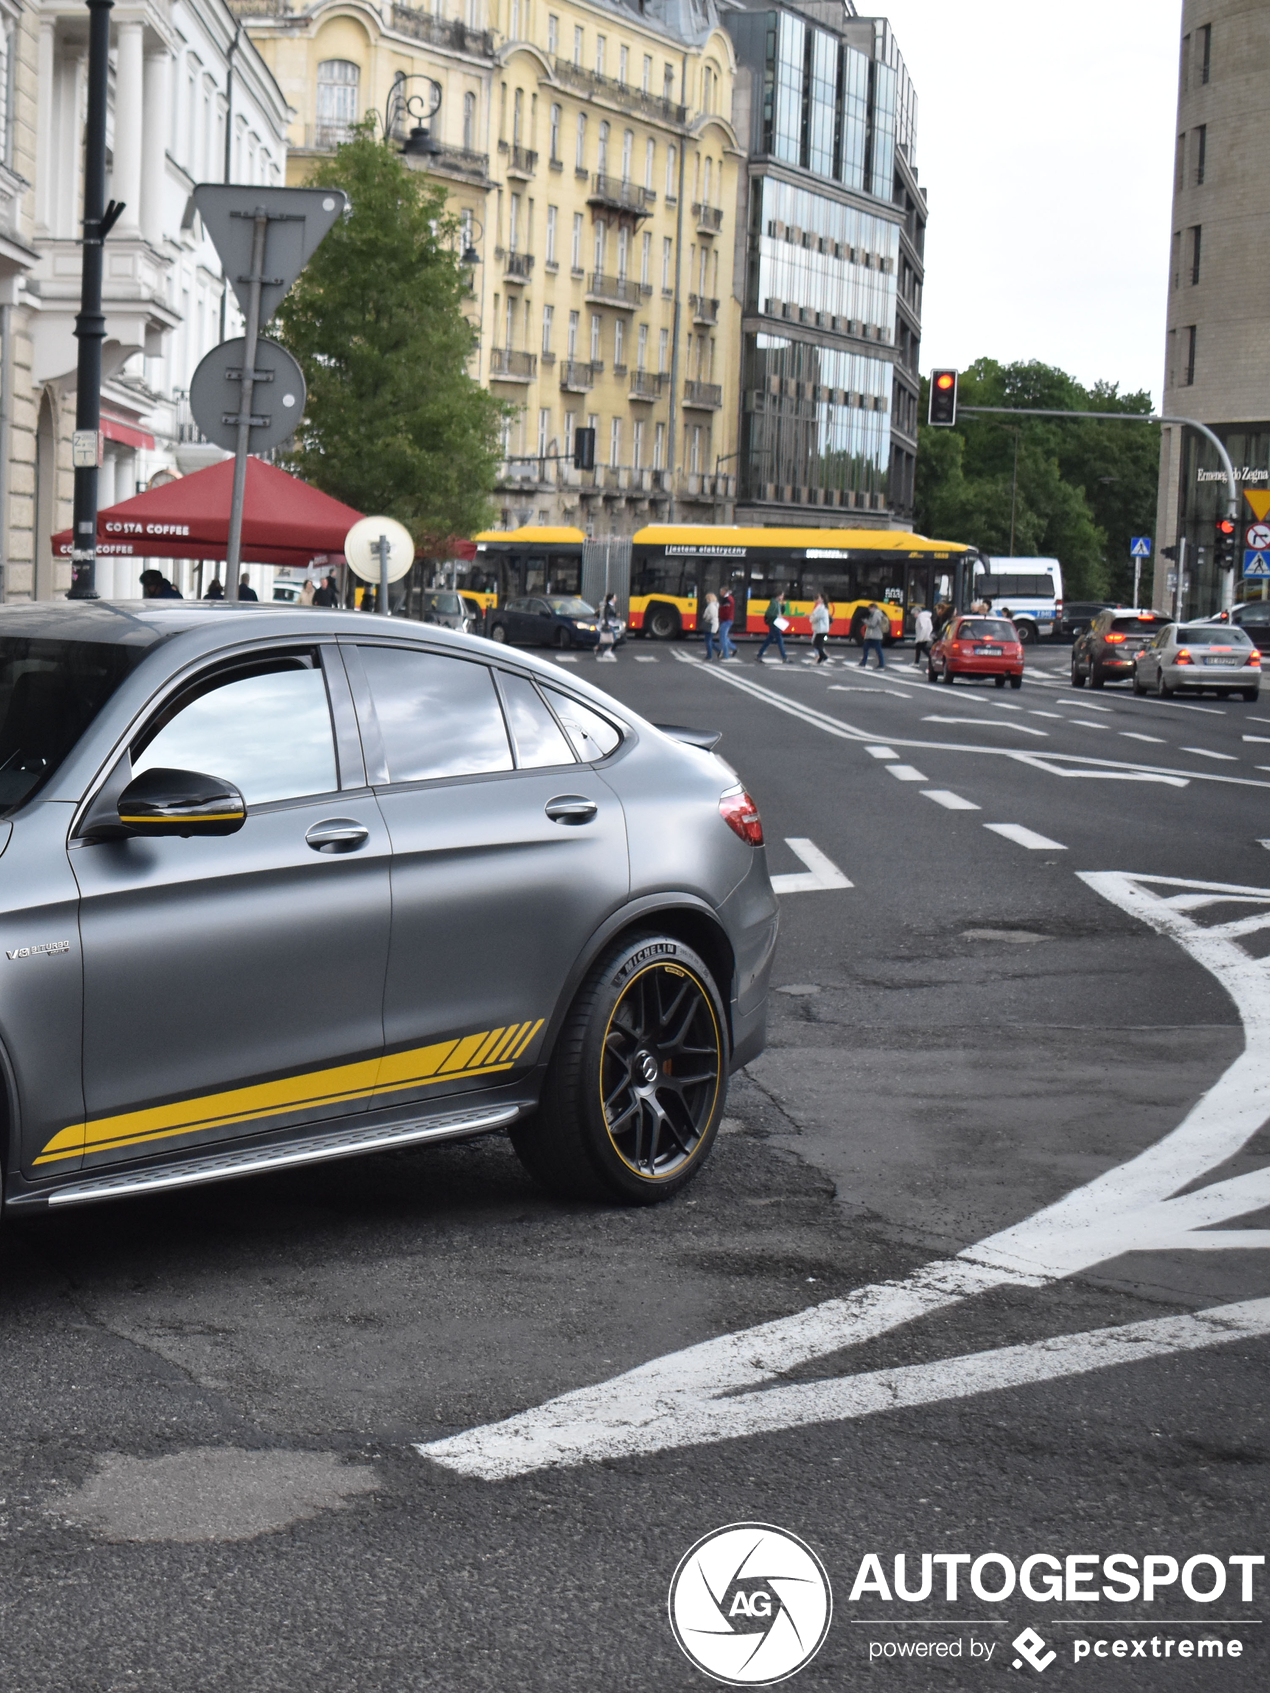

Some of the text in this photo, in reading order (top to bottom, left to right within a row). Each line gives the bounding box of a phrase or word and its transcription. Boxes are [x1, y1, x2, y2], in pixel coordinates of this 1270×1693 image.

[1242, 467, 1269, 483] Zegna
[105, 522, 189, 536] COSTA COFFEE
[96, 545, 133, 554] COFFEE
[698, 545, 747, 555] elektryczny
[6, 947, 30, 960] V8
[31, 941, 69, 953] BITURBO
[624, 944, 675, 973] MICHELIN
